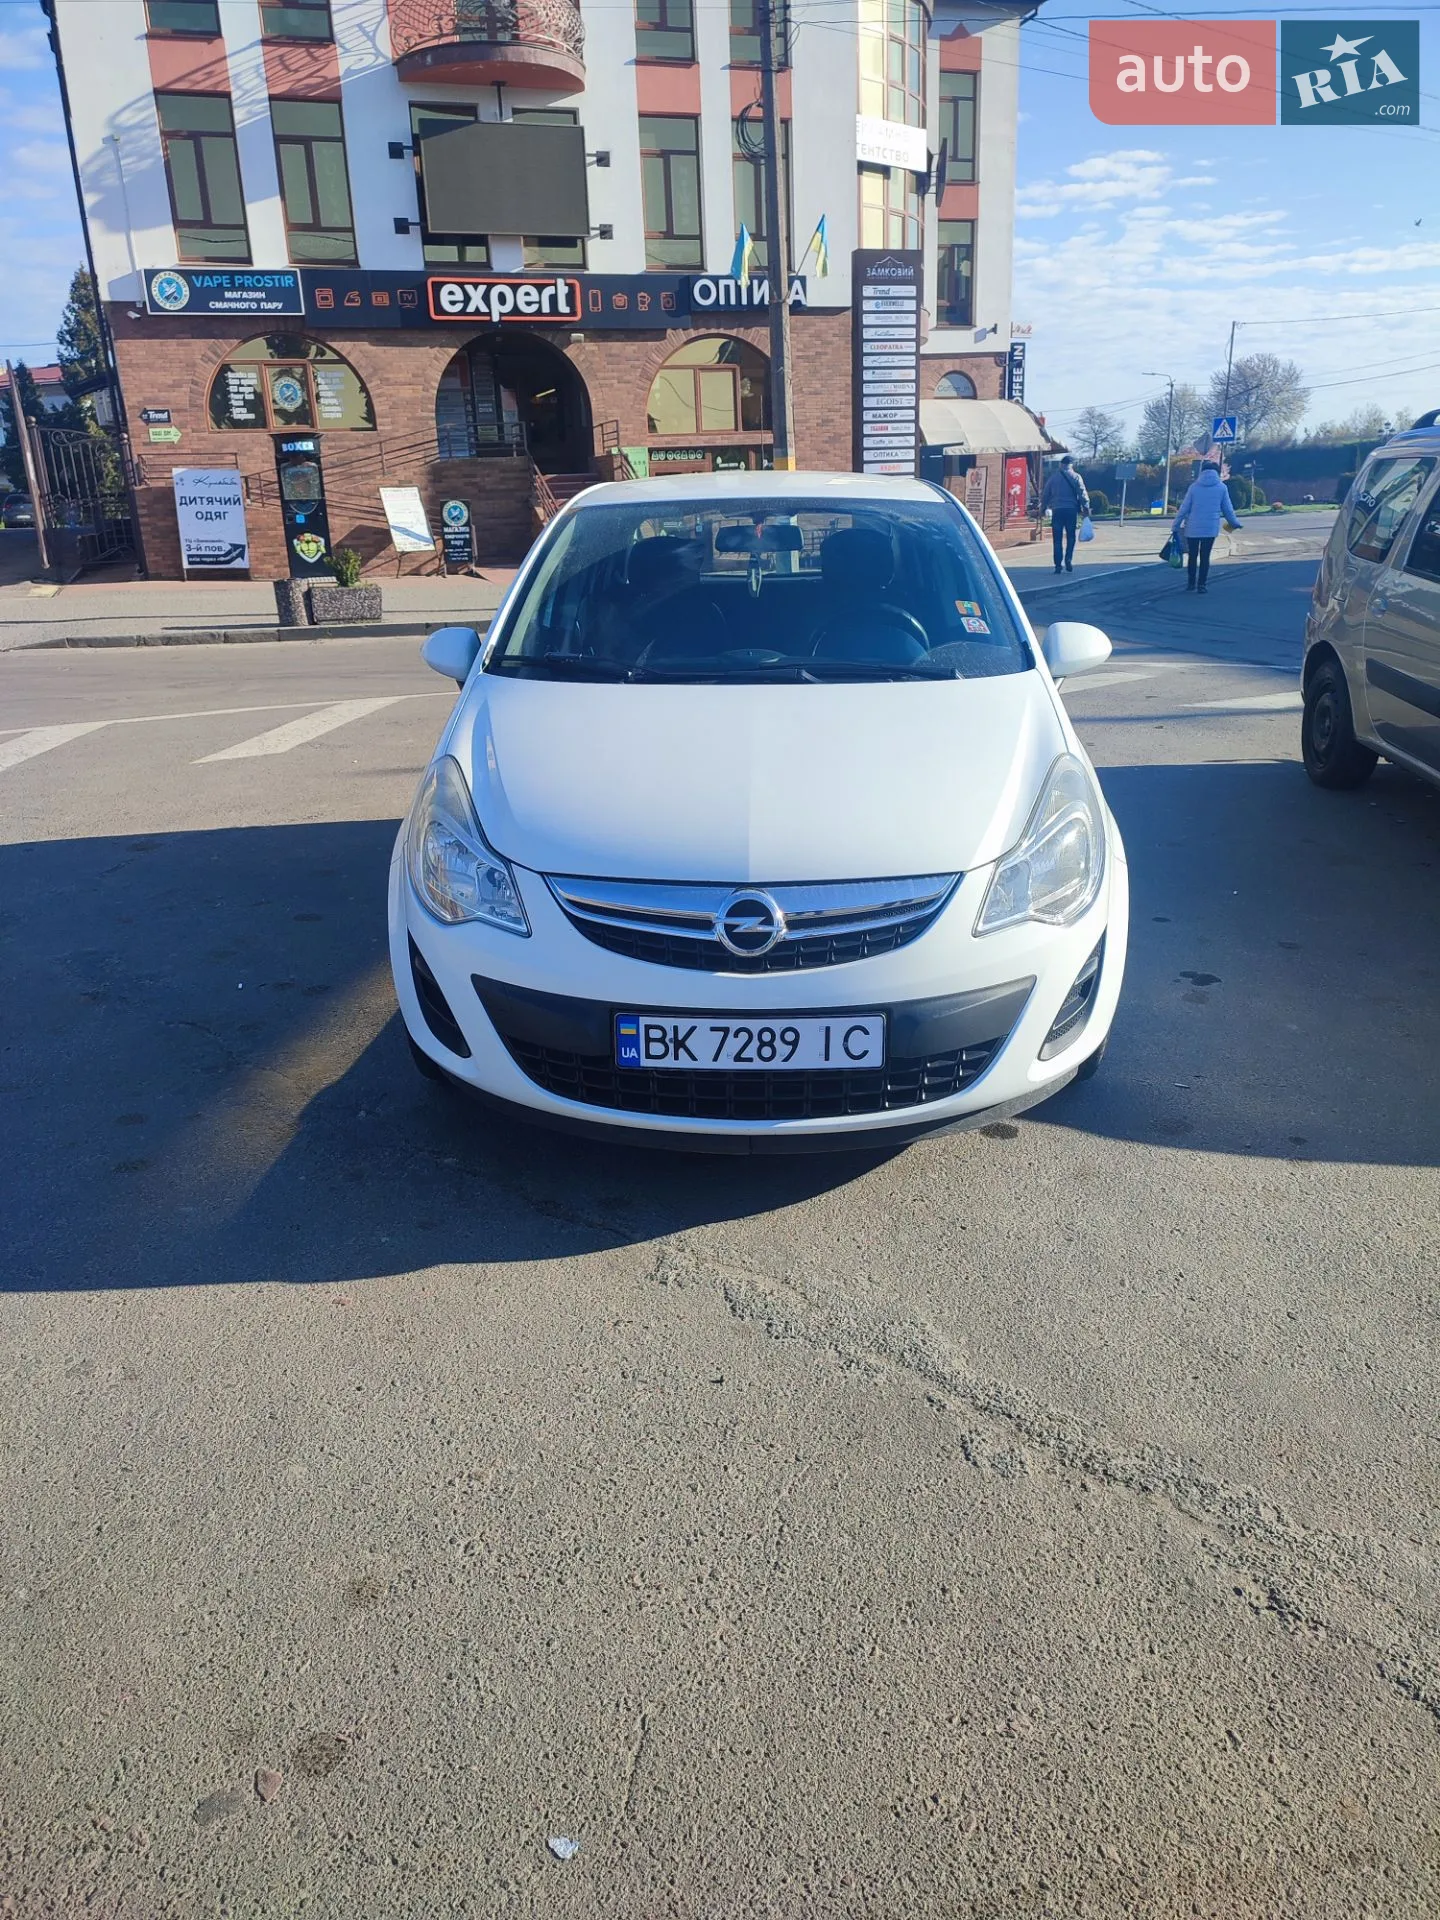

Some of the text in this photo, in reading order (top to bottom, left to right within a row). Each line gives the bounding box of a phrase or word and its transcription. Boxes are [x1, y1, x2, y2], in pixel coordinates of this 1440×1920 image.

[866, 266, 914, 276] ЗАМКОВИЙ
[192, 275, 295, 288] VAPE PROSTIR
[224, 291, 266, 299] МАГАЗИН
[692, 279, 808, 306] ОПТИА
[439, 278, 571, 322] expert
[208, 302, 284, 310] СМАЧНОГО ПАРУ
[281, 441, 315, 452] BOXER
[872, 451, 899, 459] ОПТИКА
[179, 494, 242, 507] ДИТЯЧИЙ
[195, 511, 229, 521] ОДЯГ
[643, 1023, 870, 1063] BK 7289 IC
[621, 1047, 639, 1059] UA
